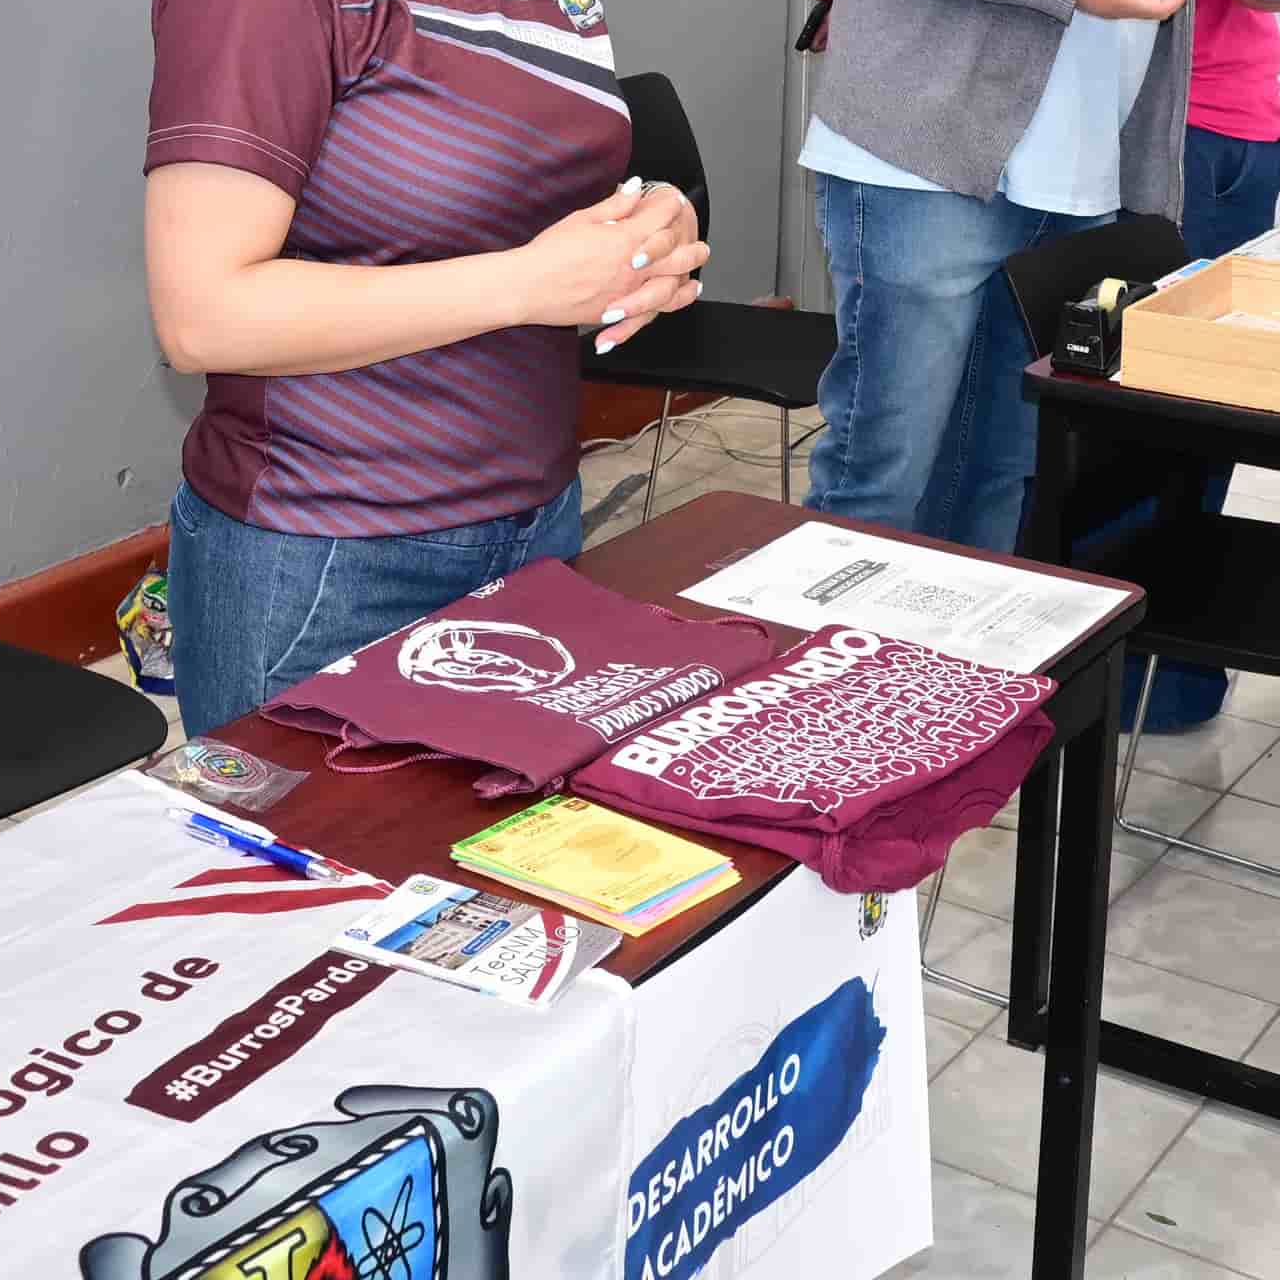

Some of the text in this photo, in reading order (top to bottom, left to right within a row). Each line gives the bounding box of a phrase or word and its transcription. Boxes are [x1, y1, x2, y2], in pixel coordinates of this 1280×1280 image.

[589, 695, 663, 738] BURROS
[651, 667, 721, 710] PARDOS
[141, 956, 219, 1002] de
[165, 958, 370, 1102] #BurrosPardo
[627, 1053, 801, 1240] DESARROLLO
[640, 1125, 795, 1280] ACADÉMICO
